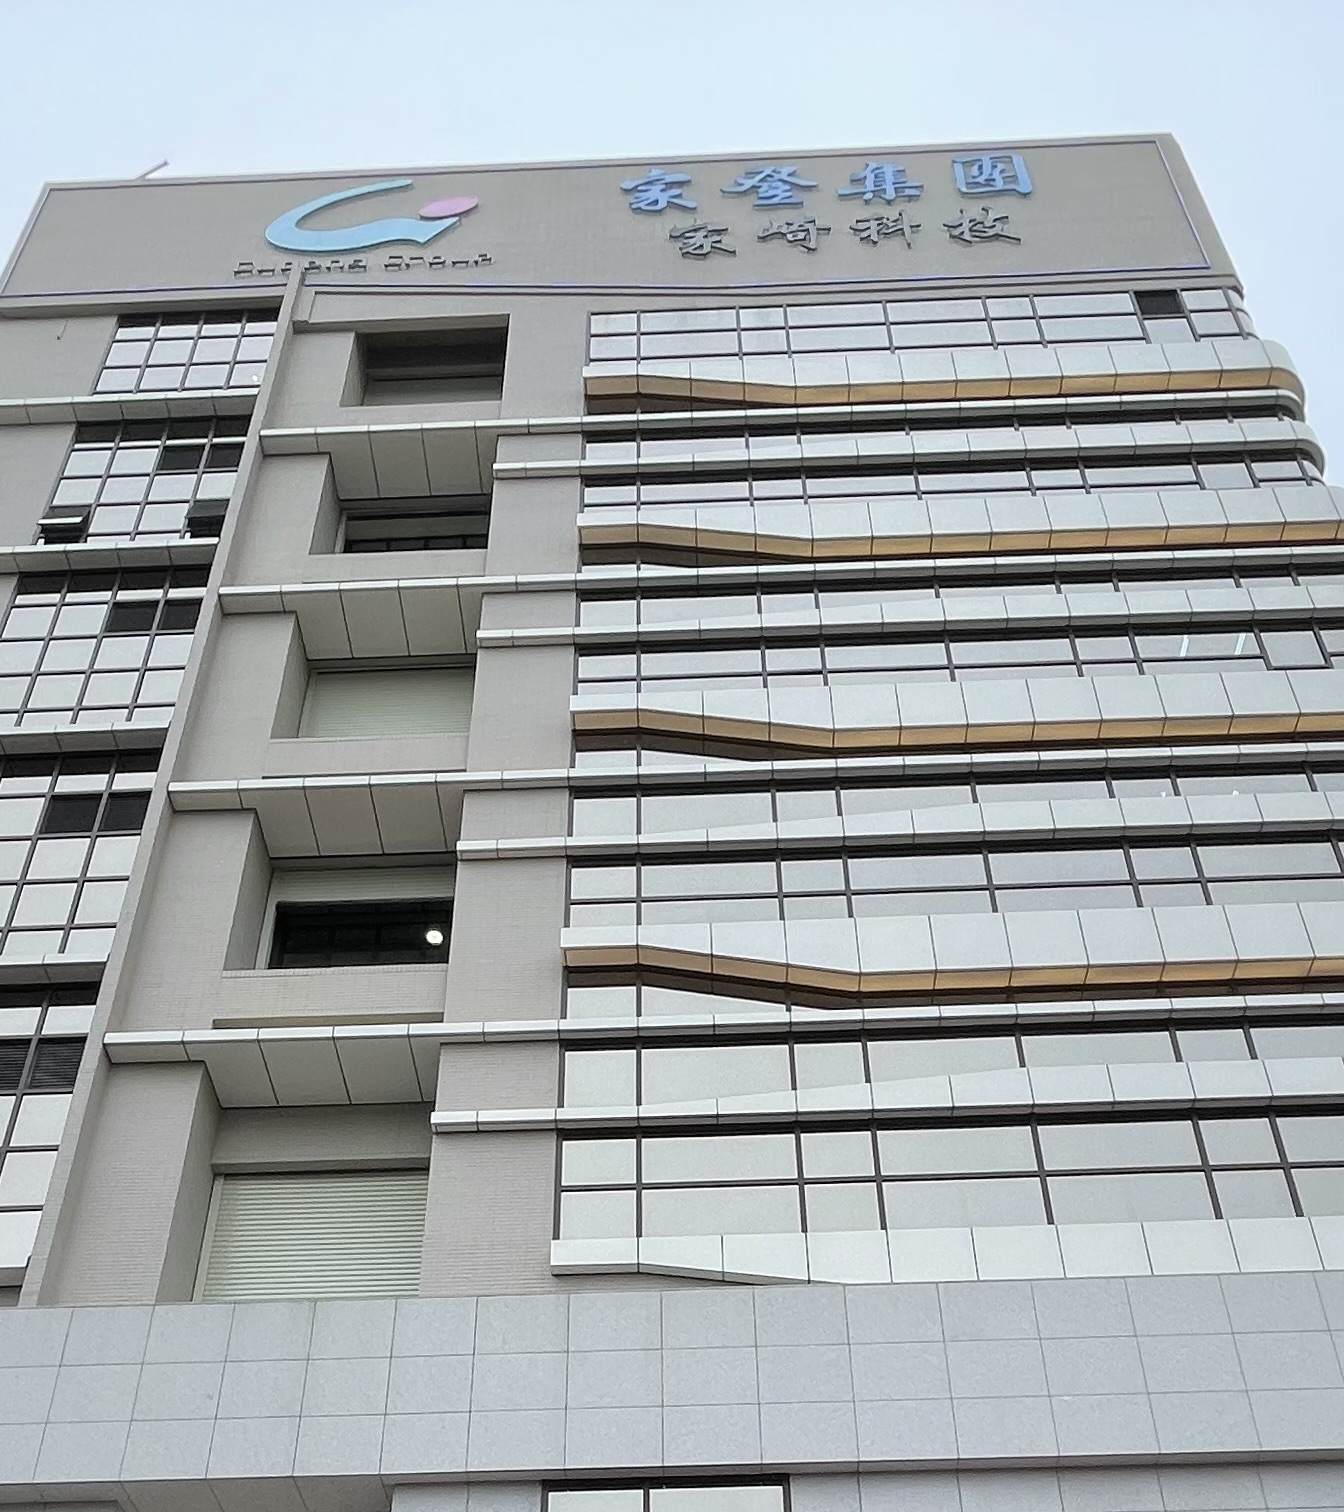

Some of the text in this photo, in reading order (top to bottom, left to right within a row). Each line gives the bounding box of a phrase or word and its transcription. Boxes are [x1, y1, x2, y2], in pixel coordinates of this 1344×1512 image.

[619, 153, 1034, 213] 家登集團
[668, 205, 1023, 260] 家崎科技
